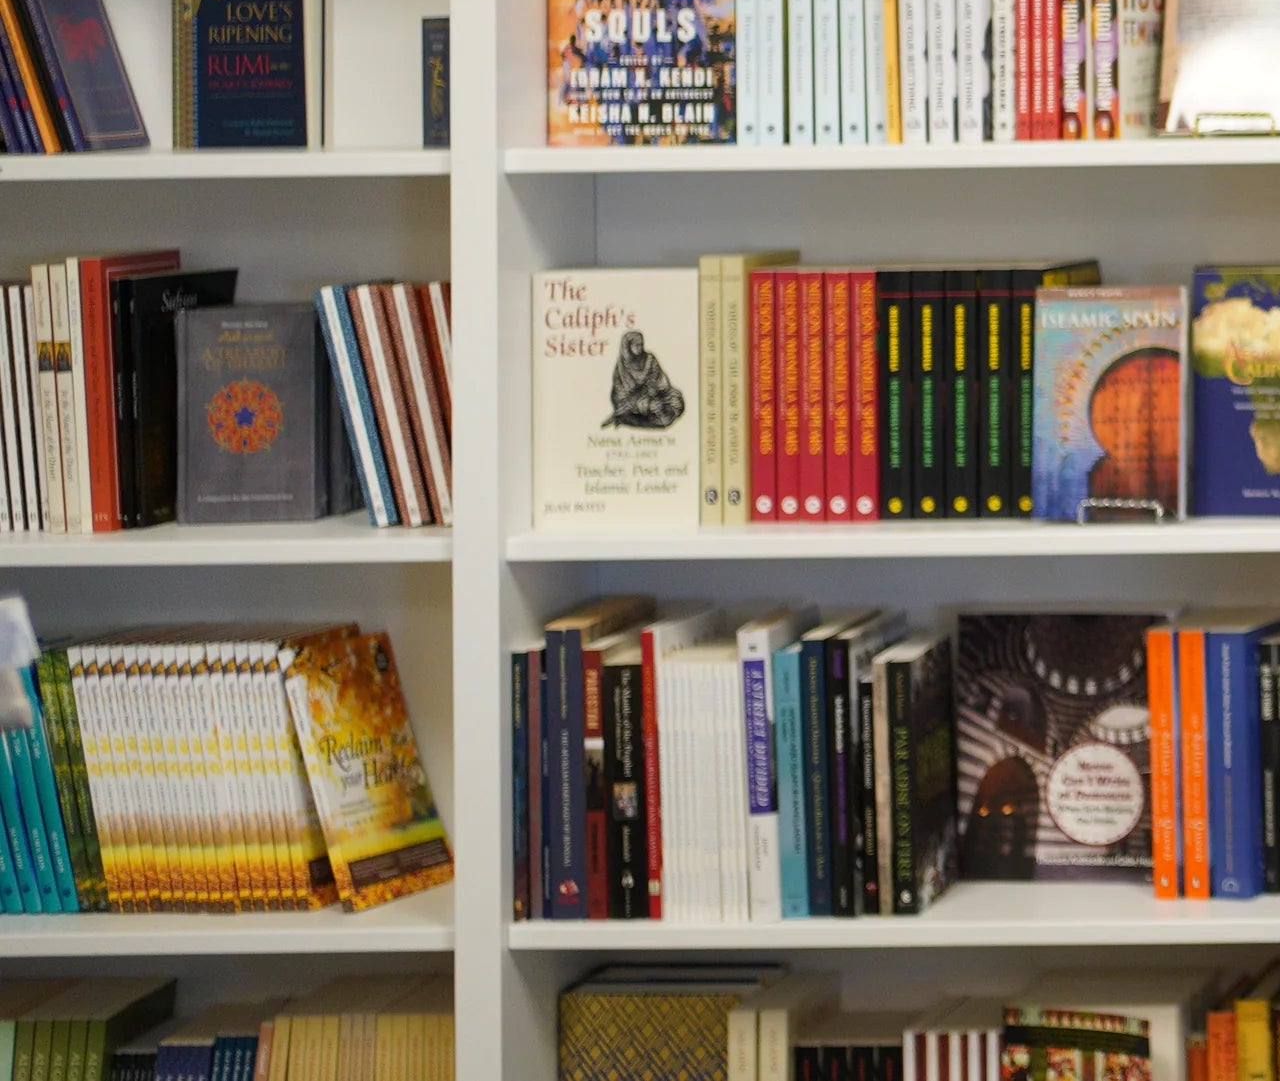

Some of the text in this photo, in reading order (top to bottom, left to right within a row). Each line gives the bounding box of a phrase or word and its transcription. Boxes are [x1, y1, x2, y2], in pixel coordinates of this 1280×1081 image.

[226, 1, 293, 21] LOVE'S
[208, 23, 292, 45] RIPENING
[585, 8, 696, 43] SOULS
[208, 54, 270, 76] RUMI
[544, 281, 587, 302] The
[544, 307, 636, 335] Caliph's
[544, 336, 610, 359] Sister
